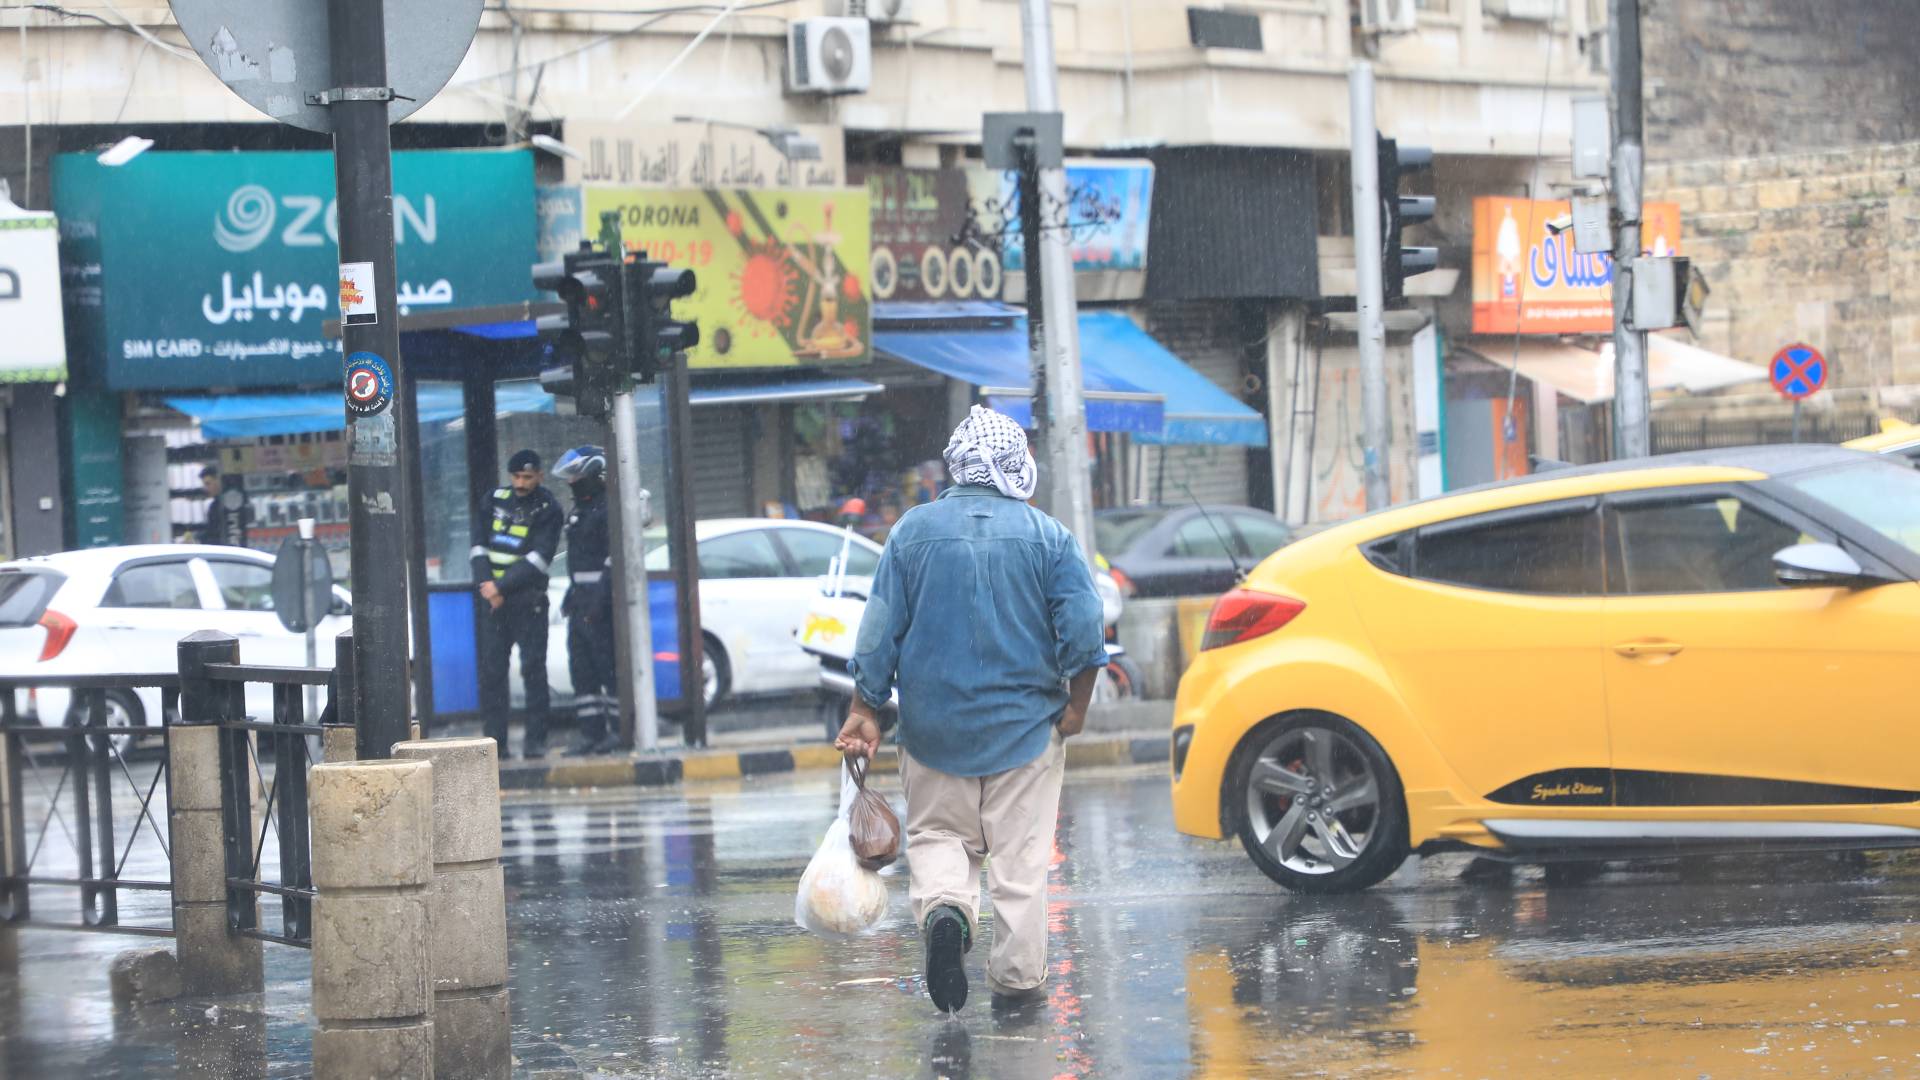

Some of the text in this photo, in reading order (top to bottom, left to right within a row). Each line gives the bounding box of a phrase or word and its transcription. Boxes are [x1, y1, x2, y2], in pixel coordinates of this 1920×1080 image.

[202, 270, 328, 324] موبايل
[122, 338, 202, 359] SIM CARD
